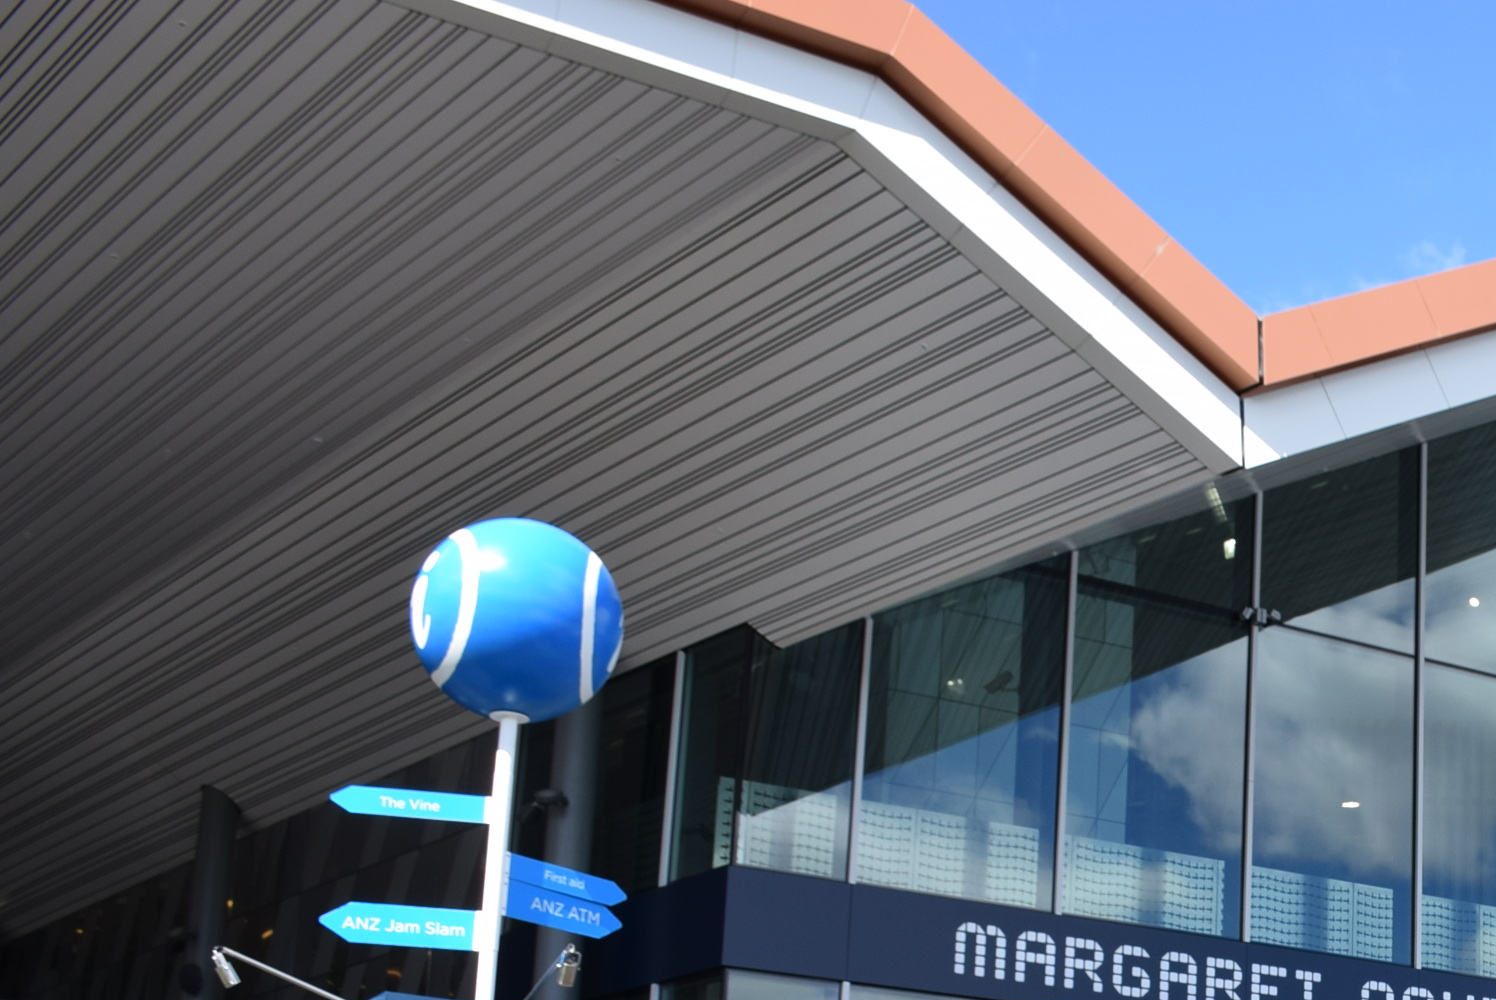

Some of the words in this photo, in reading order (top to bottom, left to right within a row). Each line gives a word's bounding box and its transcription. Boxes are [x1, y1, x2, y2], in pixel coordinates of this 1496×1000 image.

[379, 795, 406, 810] The
[408, 797, 441, 812] Vine
[544, 869, 567, 885] First
[568, 878, 586, 890] aid
[530, 896, 565, 918] ANZ
[567, 906, 601, 926] ATM
[341, 915, 381, 932] ANZ
[384, 919, 420, 934] Jam
[424, 921, 466, 937] Slam
